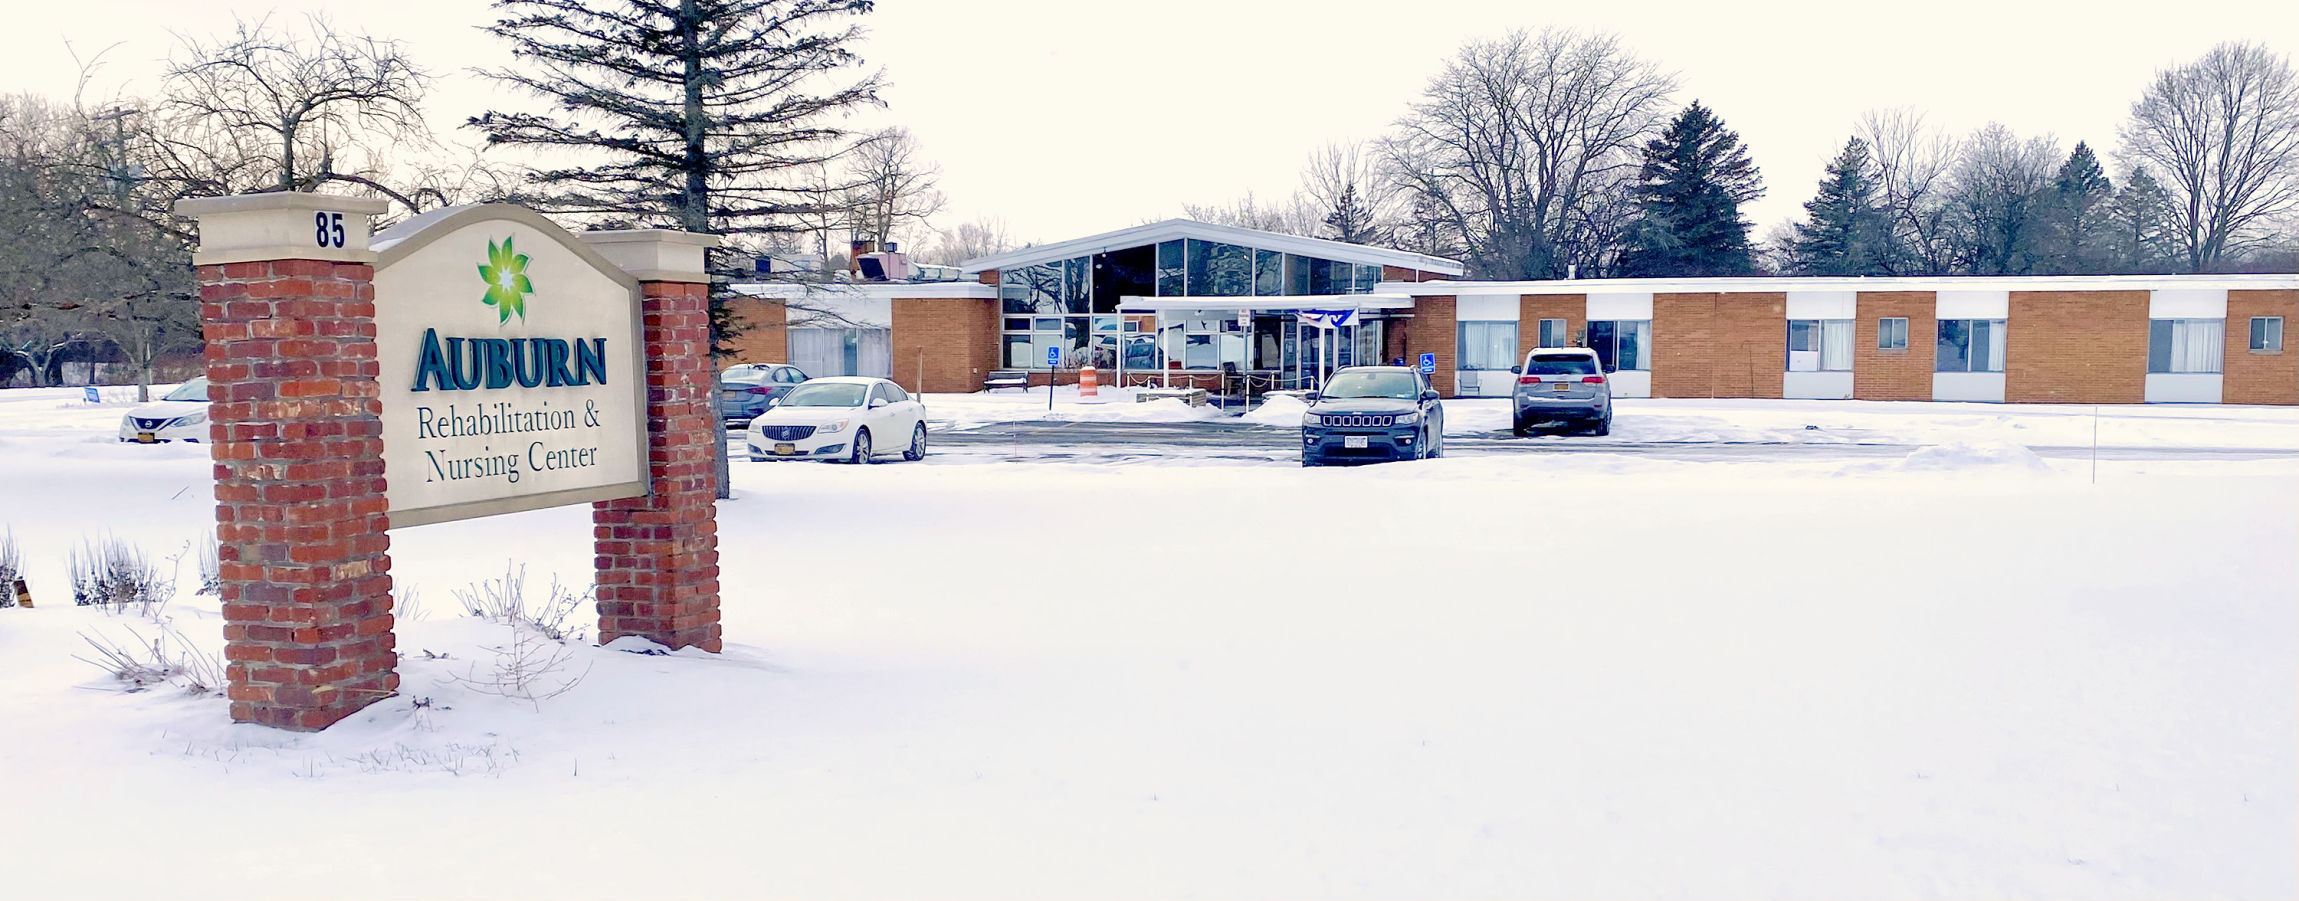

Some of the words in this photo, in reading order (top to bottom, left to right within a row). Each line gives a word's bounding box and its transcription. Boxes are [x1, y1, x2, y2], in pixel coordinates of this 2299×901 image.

[316, 211, 345, 249] 85
[411, 327, 608, 393] AUBURN
[416, 400, 576, 440] Rehabilitation
[584, 398, 601, 428] &
[425, 445, 520, 484] Nursing
[528, 441, 598, 472] Center
